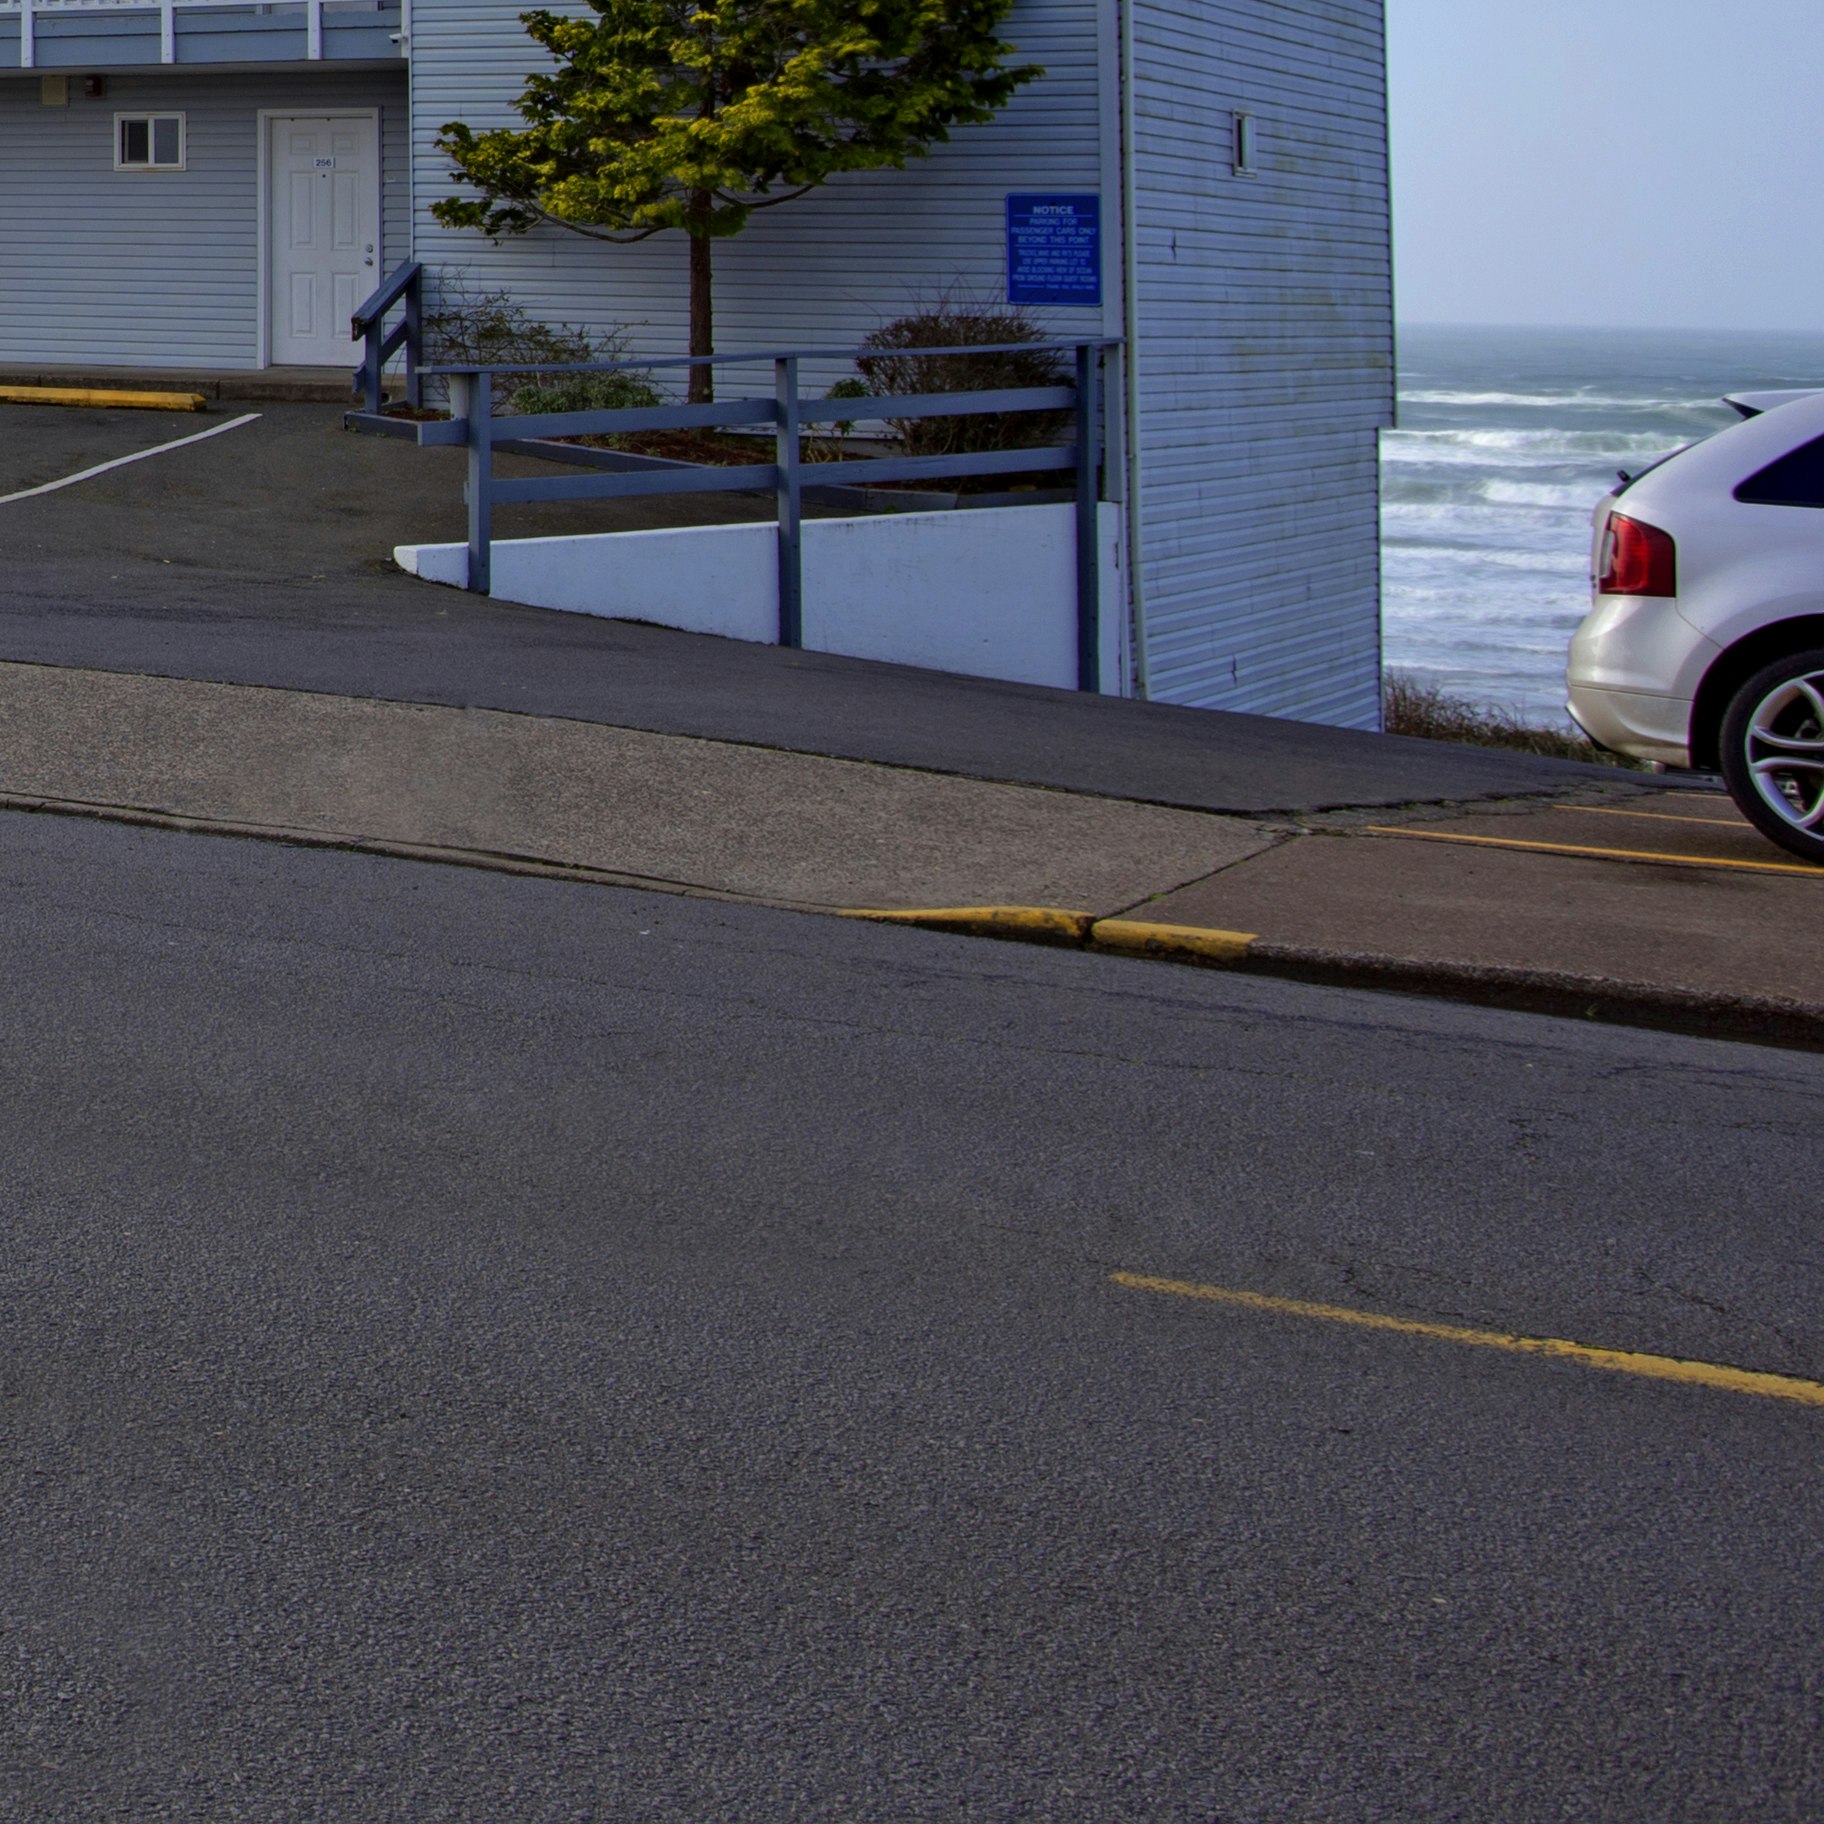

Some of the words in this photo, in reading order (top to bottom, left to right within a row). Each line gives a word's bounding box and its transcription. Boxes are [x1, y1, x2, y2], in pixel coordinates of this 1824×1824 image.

[315, 159, 331, 167] 256
[1032, 206, 1074, 215] NOTICE
[1062, 218, 1077, 226] FOR
